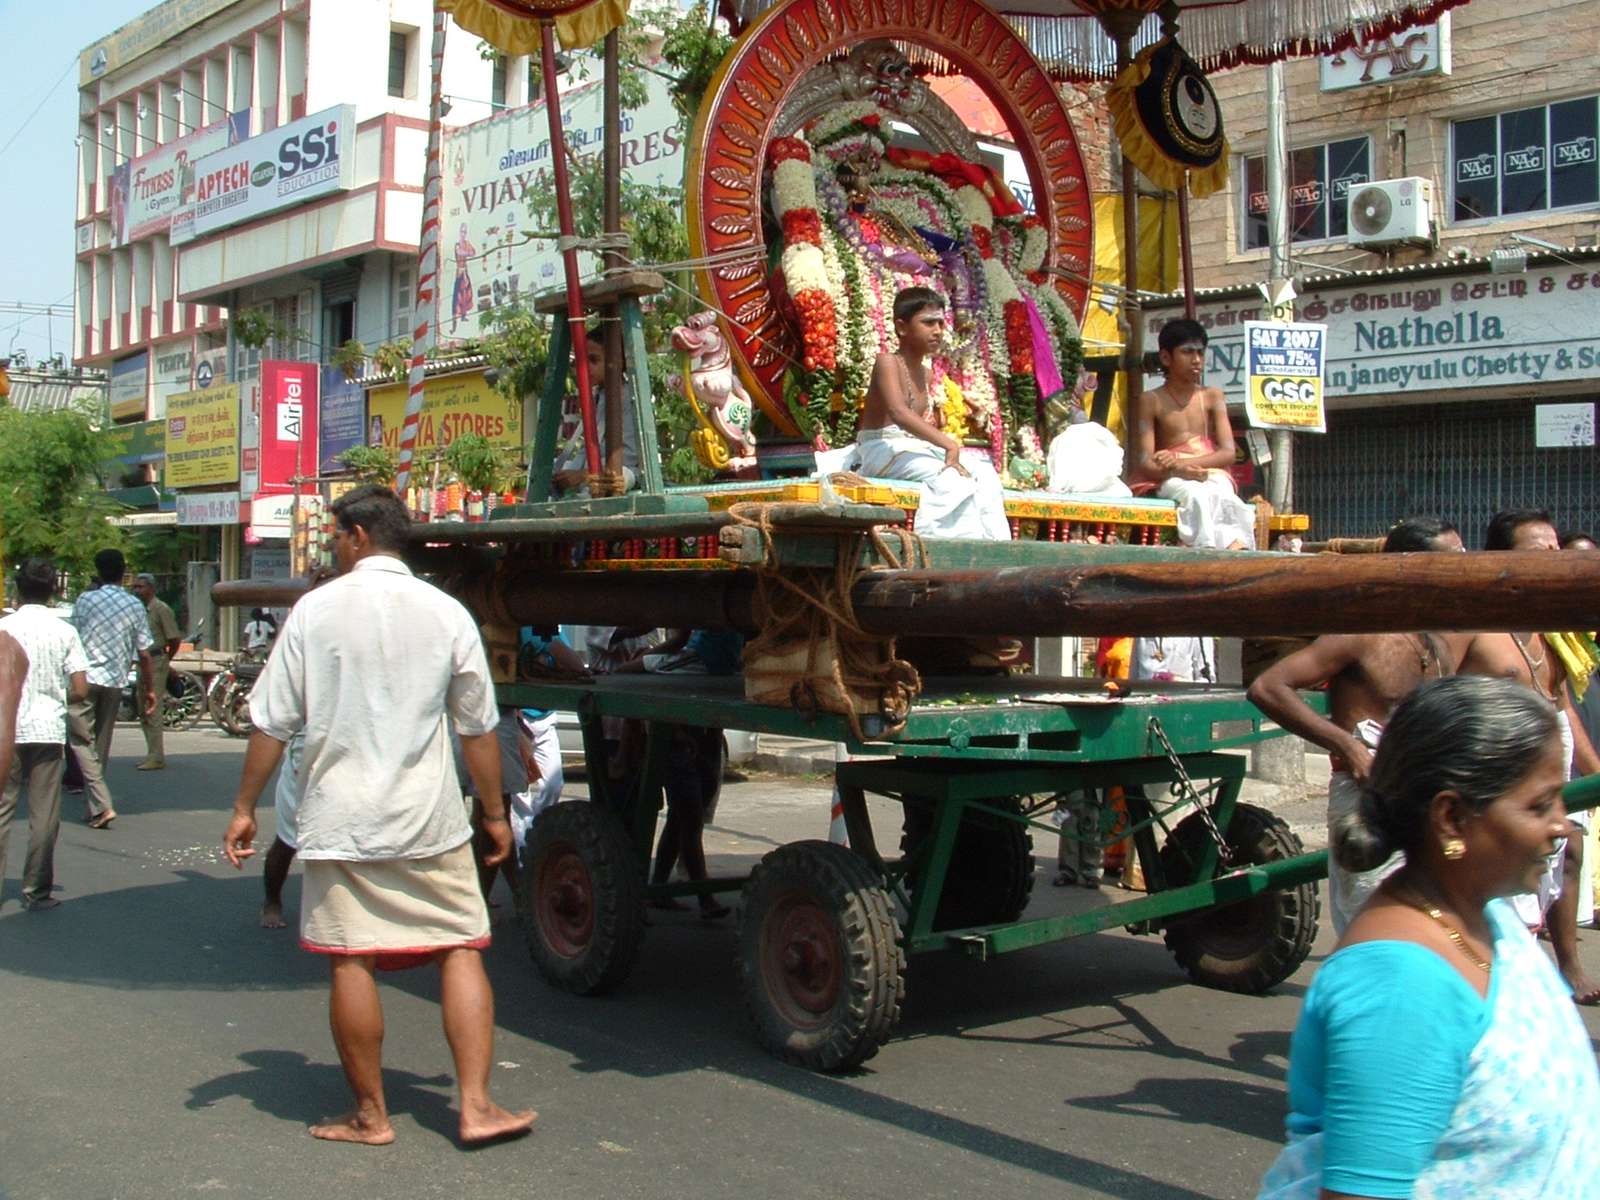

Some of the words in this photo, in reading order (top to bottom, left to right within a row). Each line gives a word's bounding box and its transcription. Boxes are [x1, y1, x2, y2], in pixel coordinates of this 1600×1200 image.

[1508, 153, 1540, 171] NAC
[1559, 144, 1591, 162] NAC
[197, 160, 249, 202] APTECH
[278, 164, 339, 194] EDUCATION
[1462, 161, 1492, 177] NAC
[1400, 198, 1412, 207] LG
[1251, 328, 1280, 347] SAT
[1282, 331, 1320, 348] 2007
[1354, 310, 1505, 352] Nathella
[1257, 354, 1285, 365] WIN
[1287, 350, 1316, 366] 75%
[1461, 351, 1551, 381] Chetty
[1554, 348, 1573, 370] &
[1261, 377, 1315, 403] CSC
[284, 378, 301, 437] Airtel
[383, 416, 434, 449] VIYA
[442, 412, 504, 446] STORES
